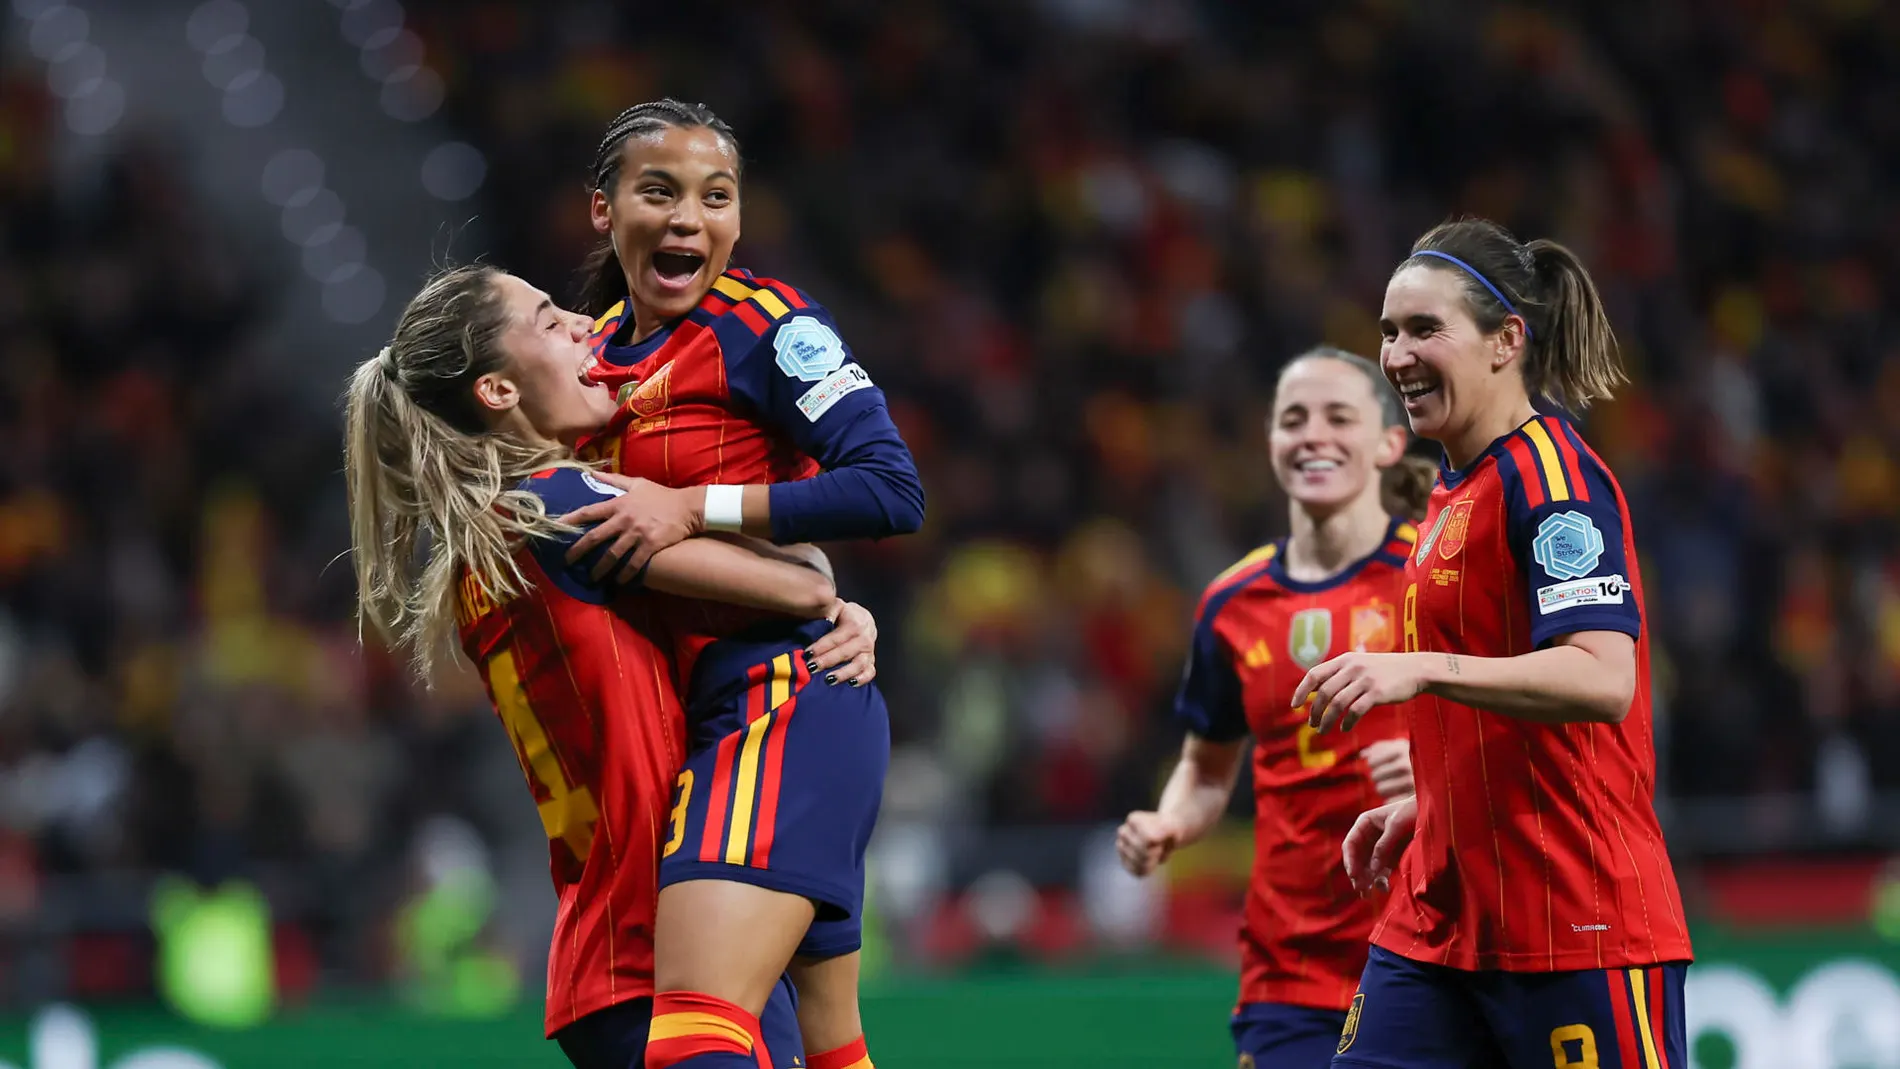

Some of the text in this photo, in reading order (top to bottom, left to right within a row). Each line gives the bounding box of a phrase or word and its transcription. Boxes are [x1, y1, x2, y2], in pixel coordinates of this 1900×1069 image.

[1555, 542, 1573, 550] Play
[1556, 548, 1583, 557] Strong
[1541, 588, 1597, 603] FOUNDATION
[488, 649, 599, 863] 4
